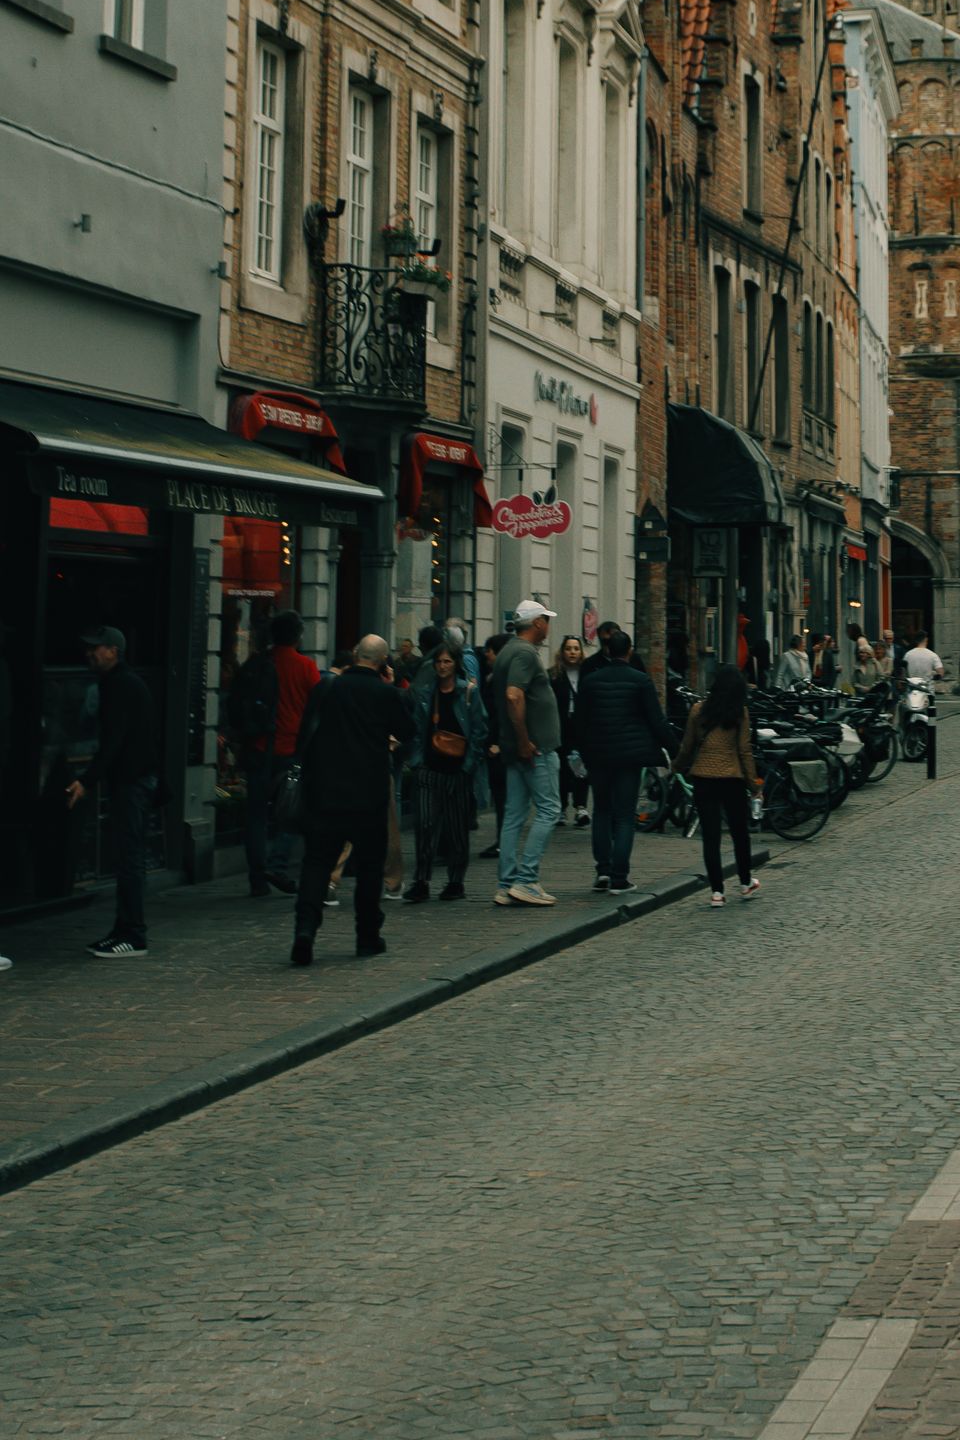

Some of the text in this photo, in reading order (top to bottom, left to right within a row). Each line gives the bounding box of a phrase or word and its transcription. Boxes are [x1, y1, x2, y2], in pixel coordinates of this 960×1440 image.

[56, 466, 109, 497] Tea room
[166, 479, 210, 511] PLACE
[209, 484, 231, 513] DE
